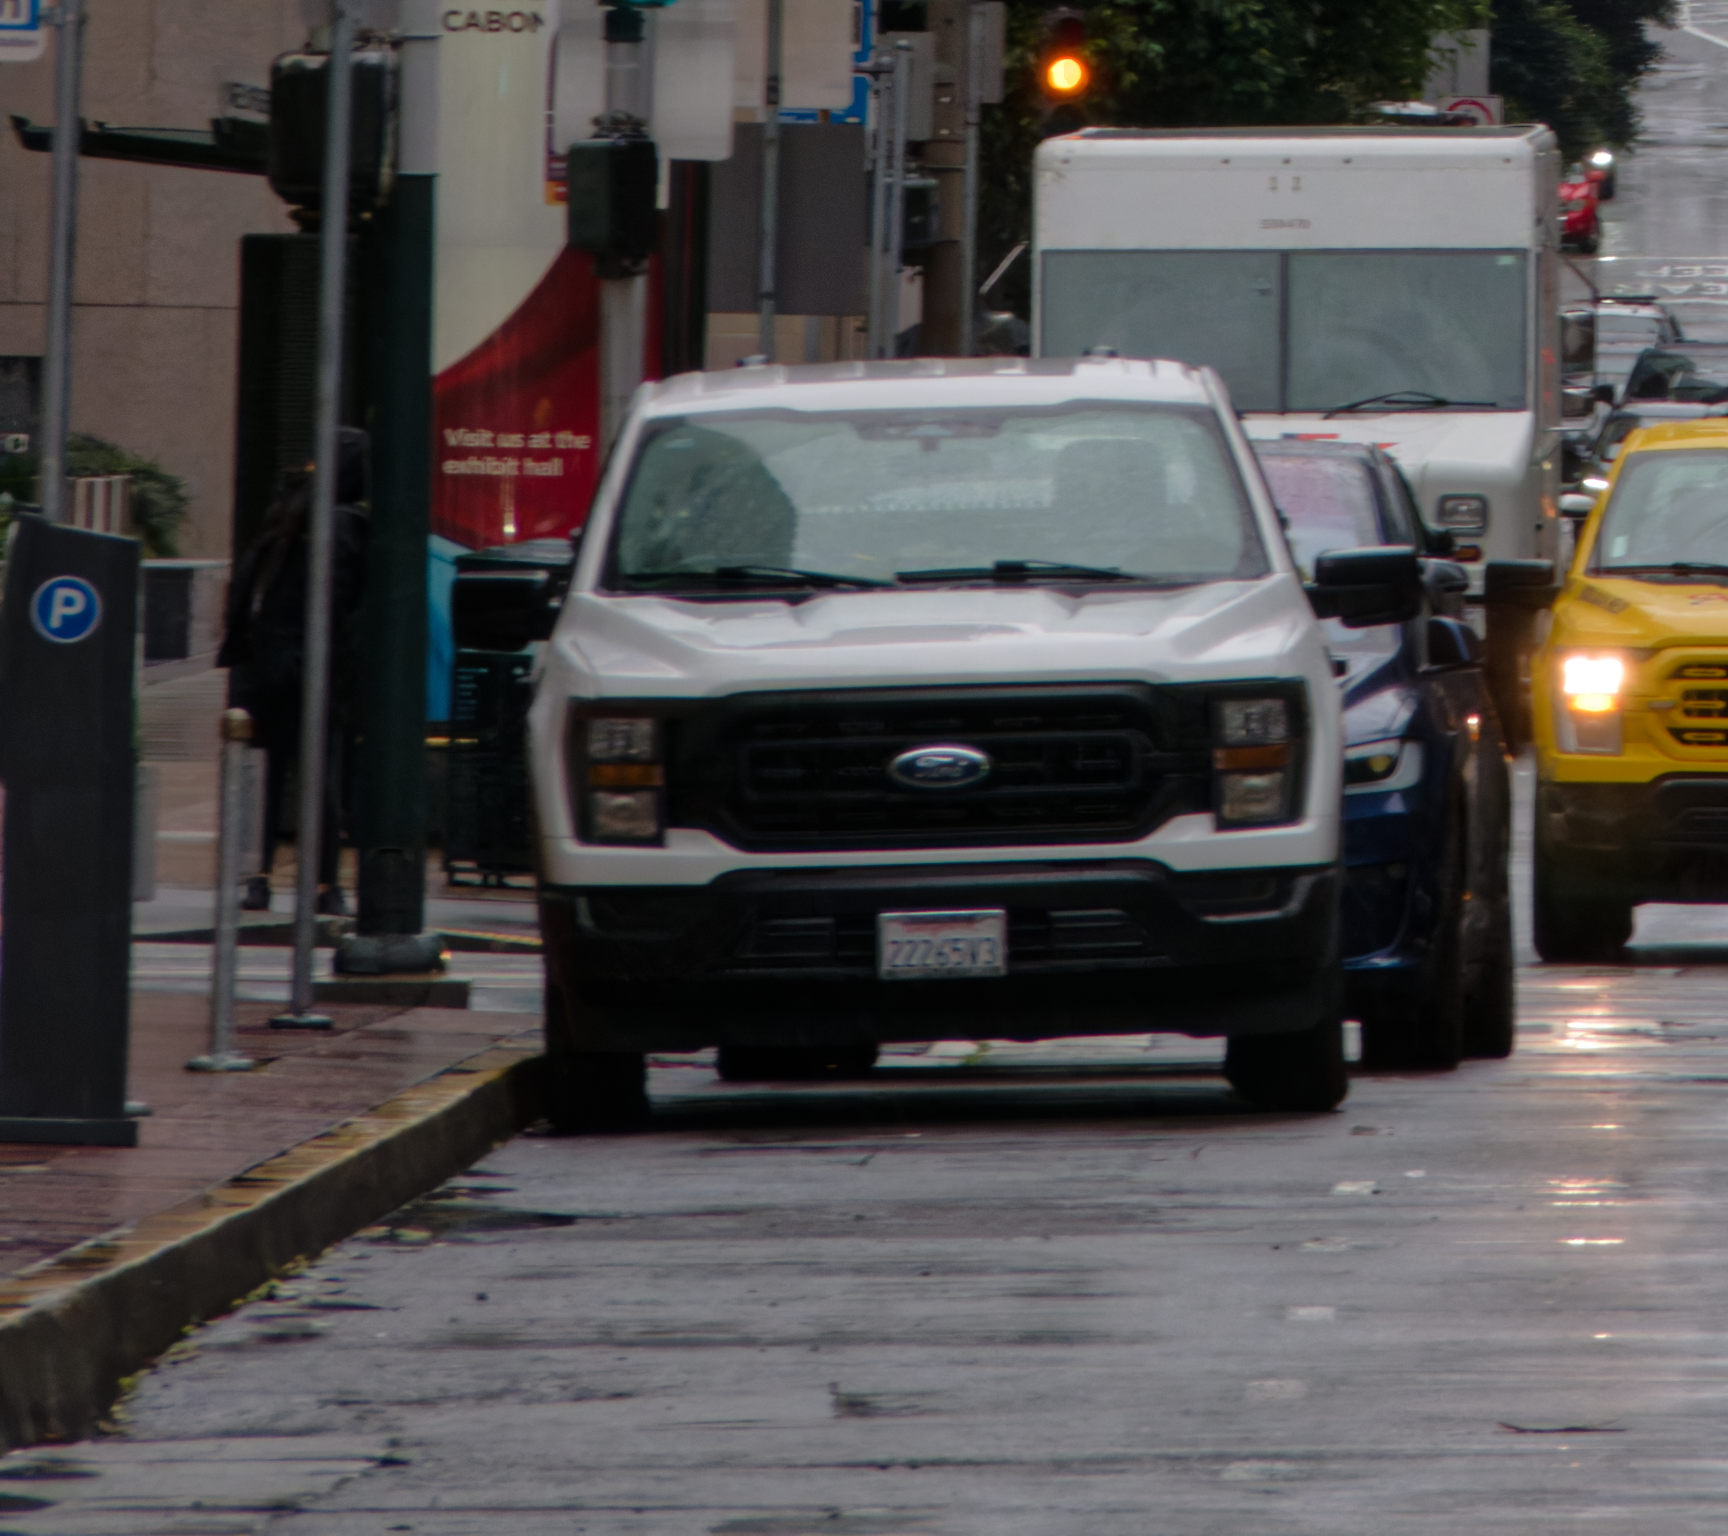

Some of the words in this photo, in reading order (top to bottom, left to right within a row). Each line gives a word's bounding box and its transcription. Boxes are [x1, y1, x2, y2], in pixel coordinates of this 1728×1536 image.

[443, 427, 494, 447] Visit
[554, 430, 592, 450] the
[441, 455, 520, 476] exhibit
[522, 456, 565, 477] hall
[49, 586, 87, 629] P
